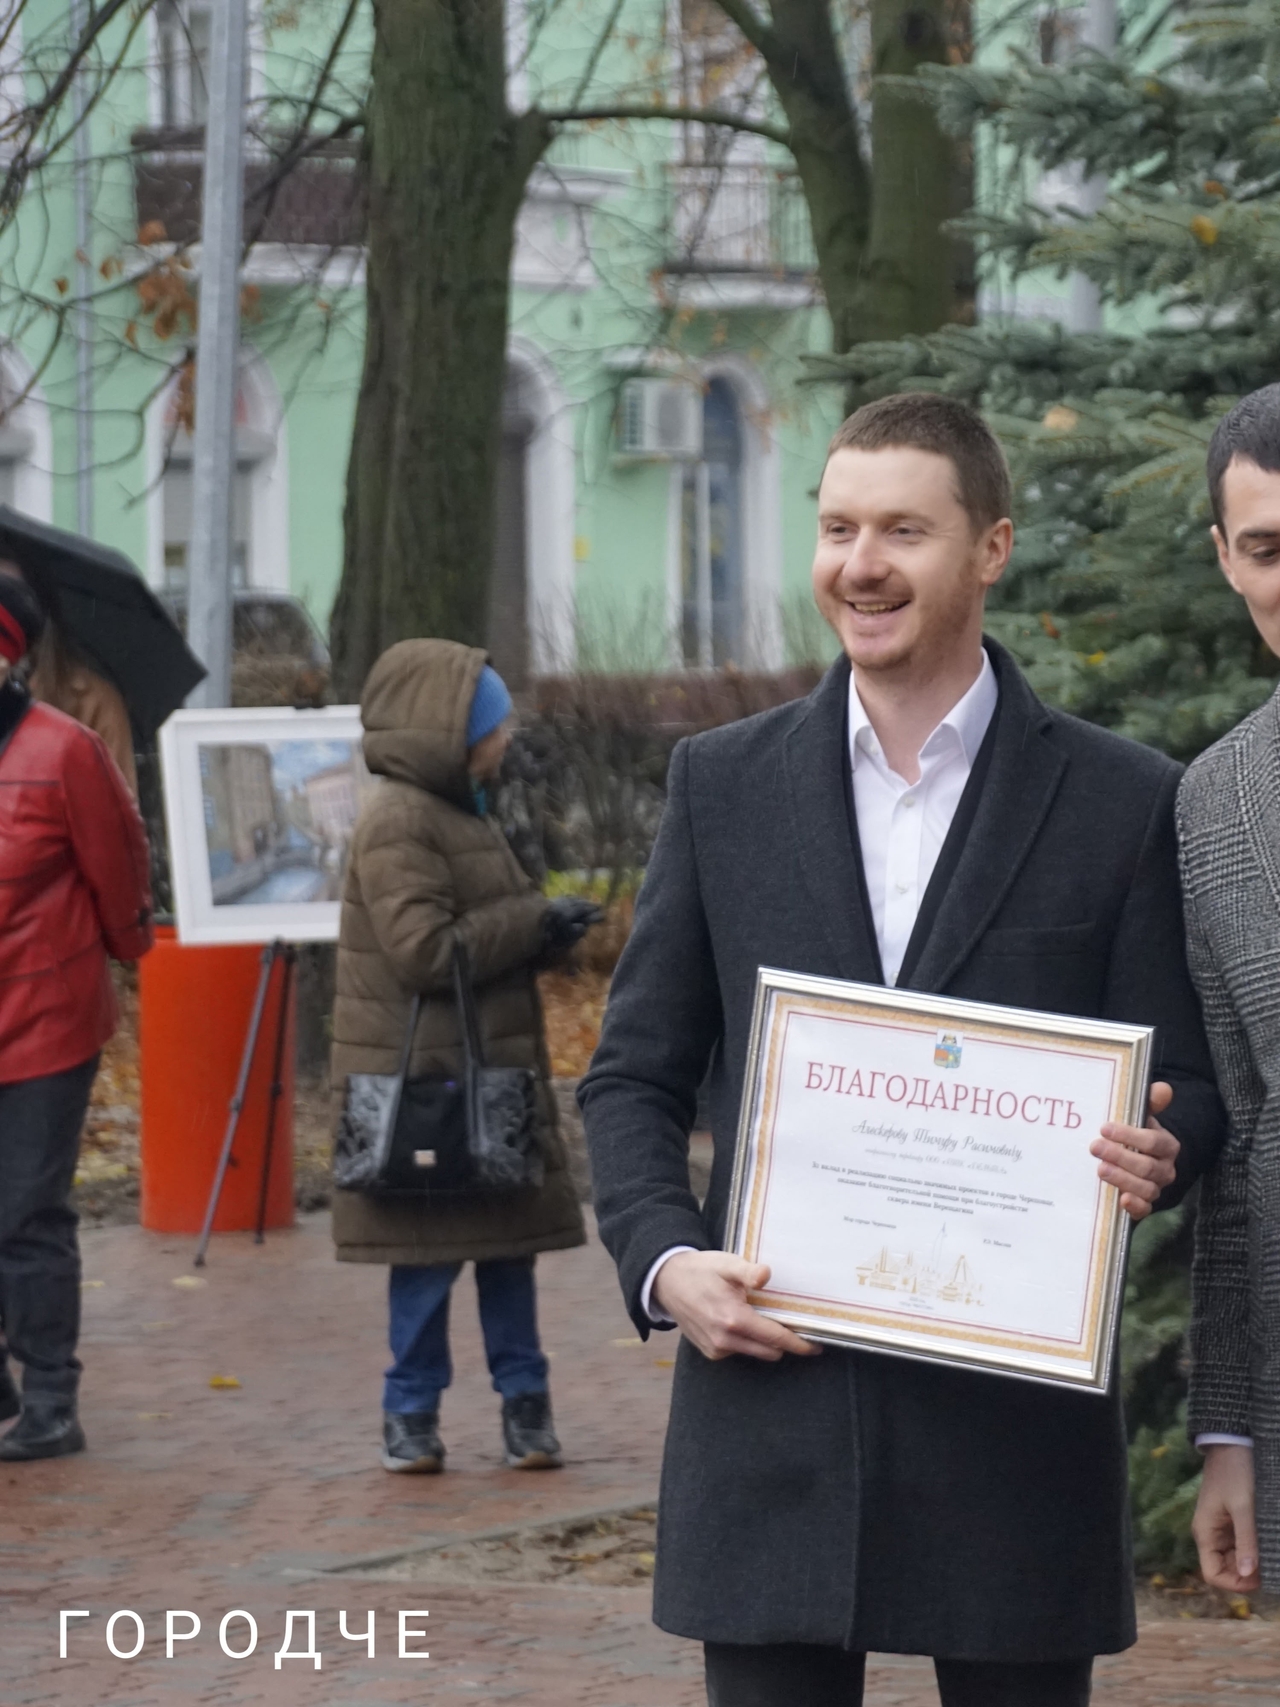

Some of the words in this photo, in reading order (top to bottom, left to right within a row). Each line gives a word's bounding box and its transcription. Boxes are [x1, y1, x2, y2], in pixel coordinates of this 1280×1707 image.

[804, 1061, 1082, 1129] БЛАГОДАРНОСТЬ
[913, 1128, 959, 1152] Тимуру
[812, 1161, 820, 1169] За
